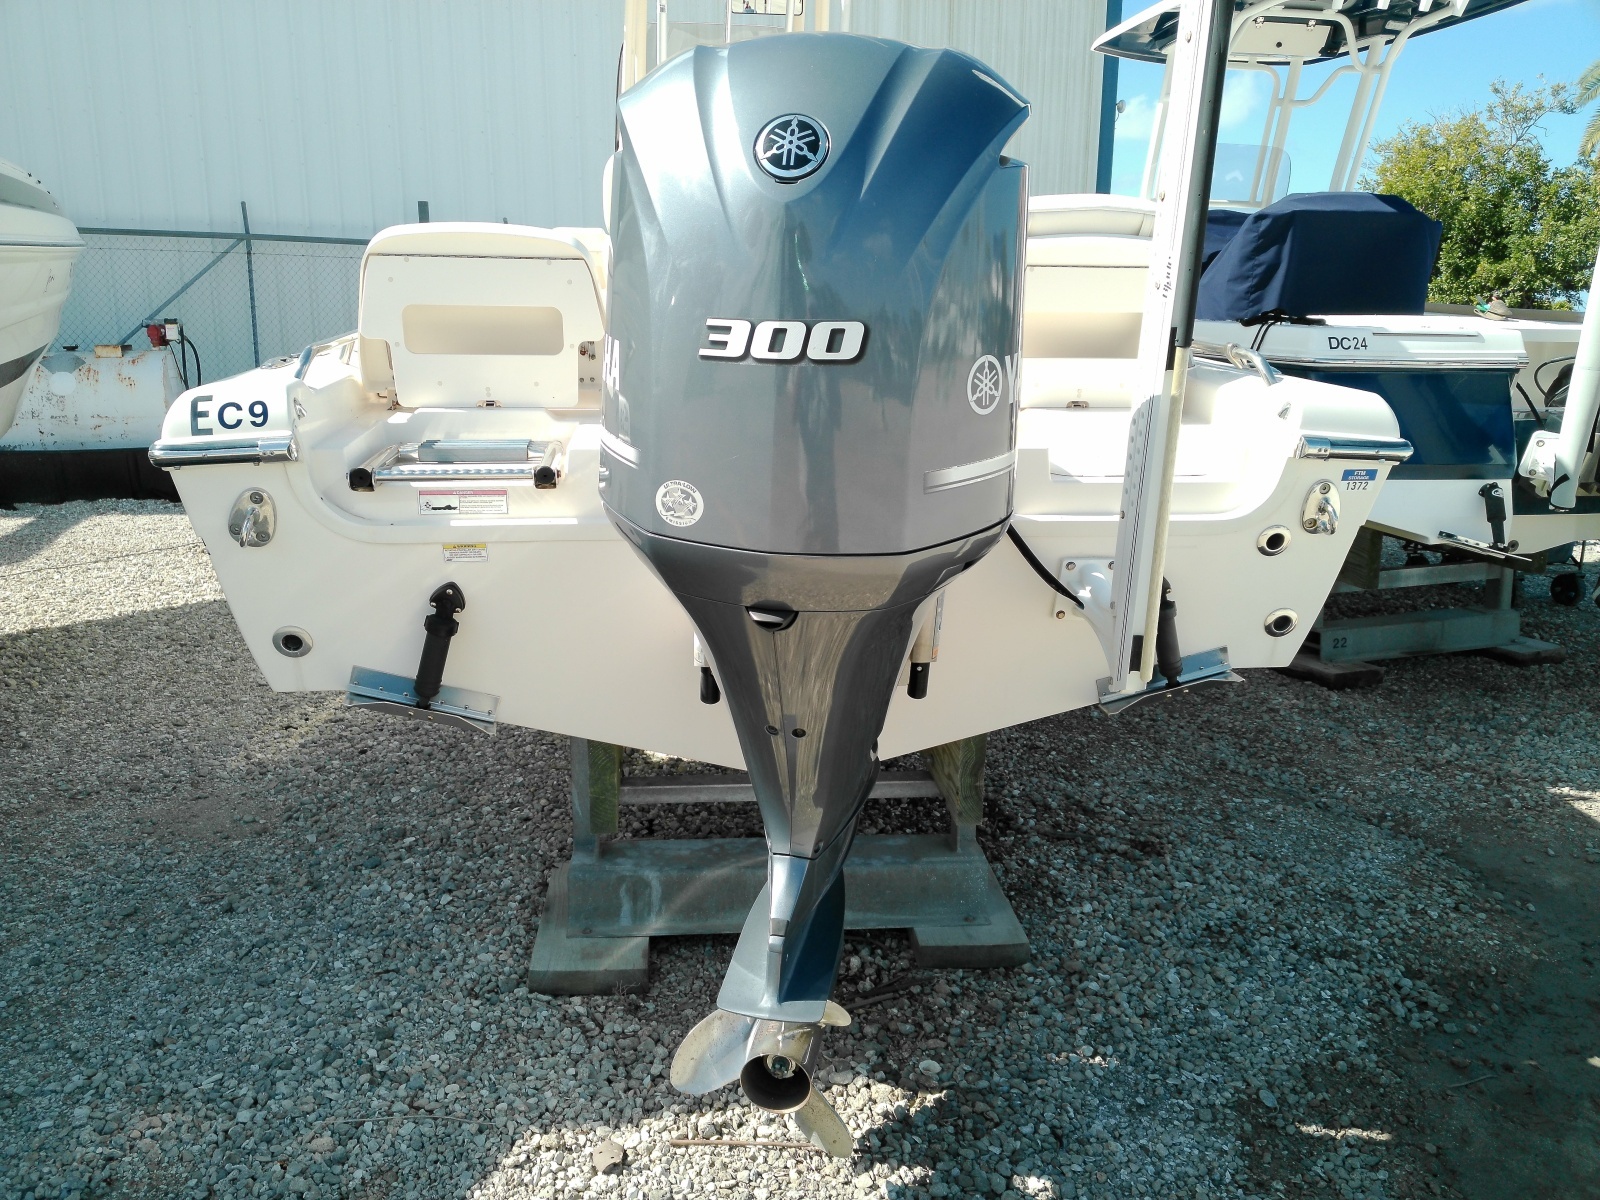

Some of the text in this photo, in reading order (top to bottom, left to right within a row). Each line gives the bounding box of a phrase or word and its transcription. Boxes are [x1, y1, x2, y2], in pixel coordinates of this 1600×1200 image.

[698, 318, 865, 360] 300
[1328, 336, 1369, 350] DC24
[1346, 481, 1368, 490] 1372
[1332, 637, 1348, 649] 22
